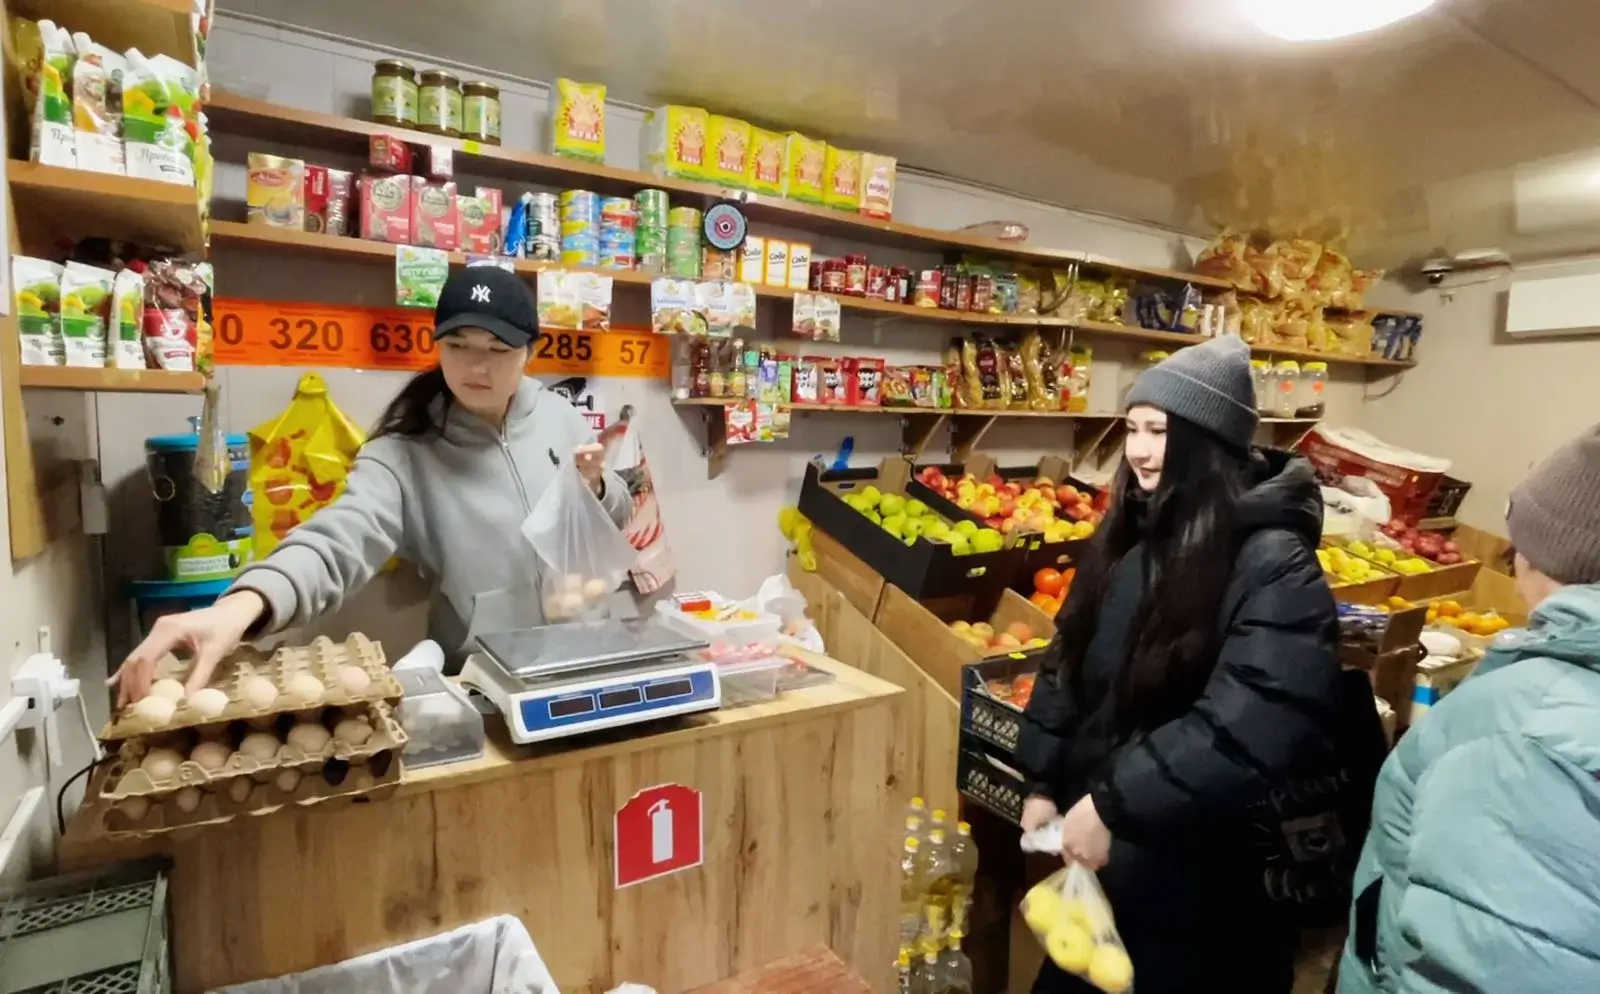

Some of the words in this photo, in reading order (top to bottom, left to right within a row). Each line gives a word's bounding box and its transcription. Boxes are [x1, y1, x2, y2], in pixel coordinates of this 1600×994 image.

[471, 284, 491, 303] NY
[213, 313, 243, 346] 0
[268, 317, 344, 352] 320
[370, 322, 435, 354] 630
[537, 332, 592, 361] 285
[620, 339, 651, 365] 57
